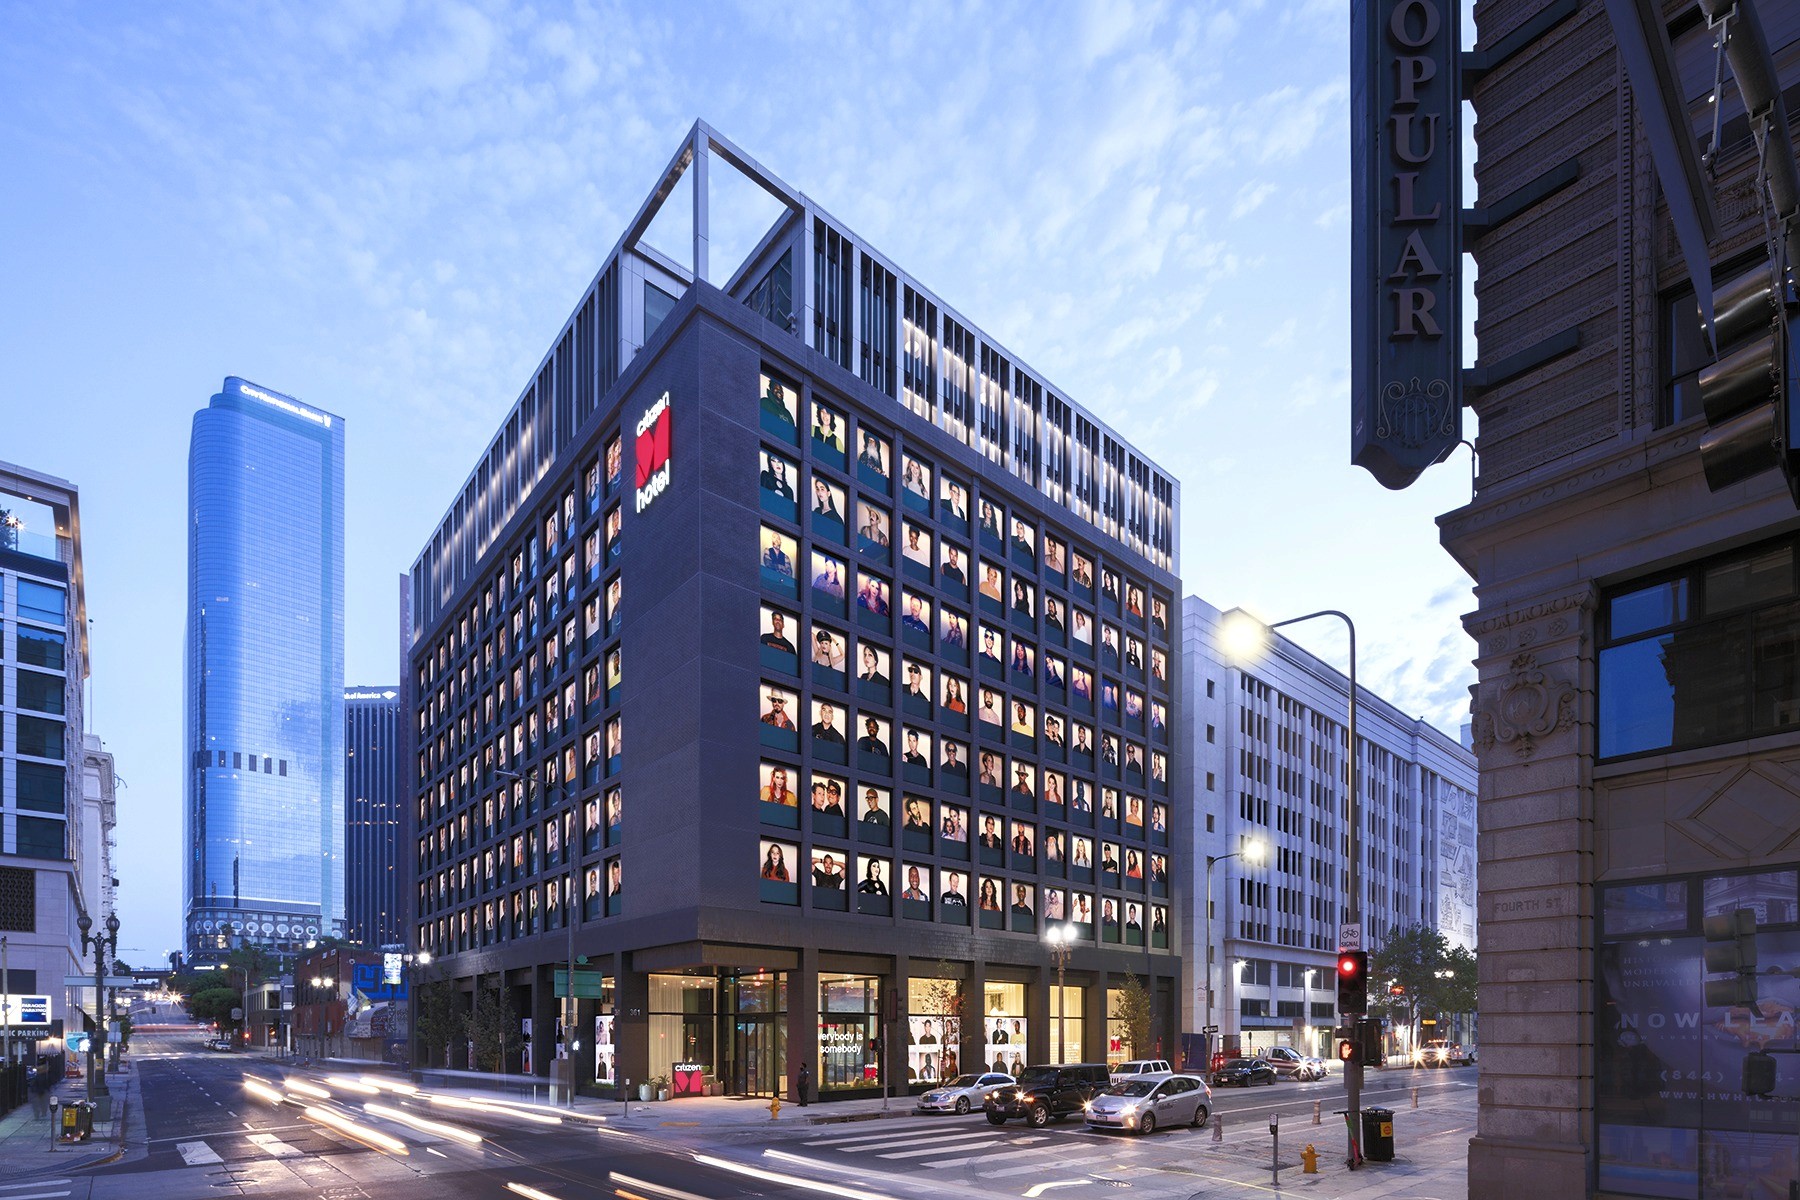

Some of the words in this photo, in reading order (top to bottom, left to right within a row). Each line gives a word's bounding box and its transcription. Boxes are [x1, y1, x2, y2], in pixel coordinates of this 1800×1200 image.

[1389, 0, 1442, 339] OPULAR
[636, 458, 670, 513] hotel
[1495, 900, 1540, 913] FOURTH
[1621, 1012, 1700, 1029] NOW
[1725, 1011, 1795, 1028] LEA
[818, 1031, 854, 1043] verybody
[857, 1032, 863, 1040] is
[820, 1044, 862, 1055] somebody
[675, 1063, 701, 1072] citizen
[1659, 1070, 1723, 1083] (844)
